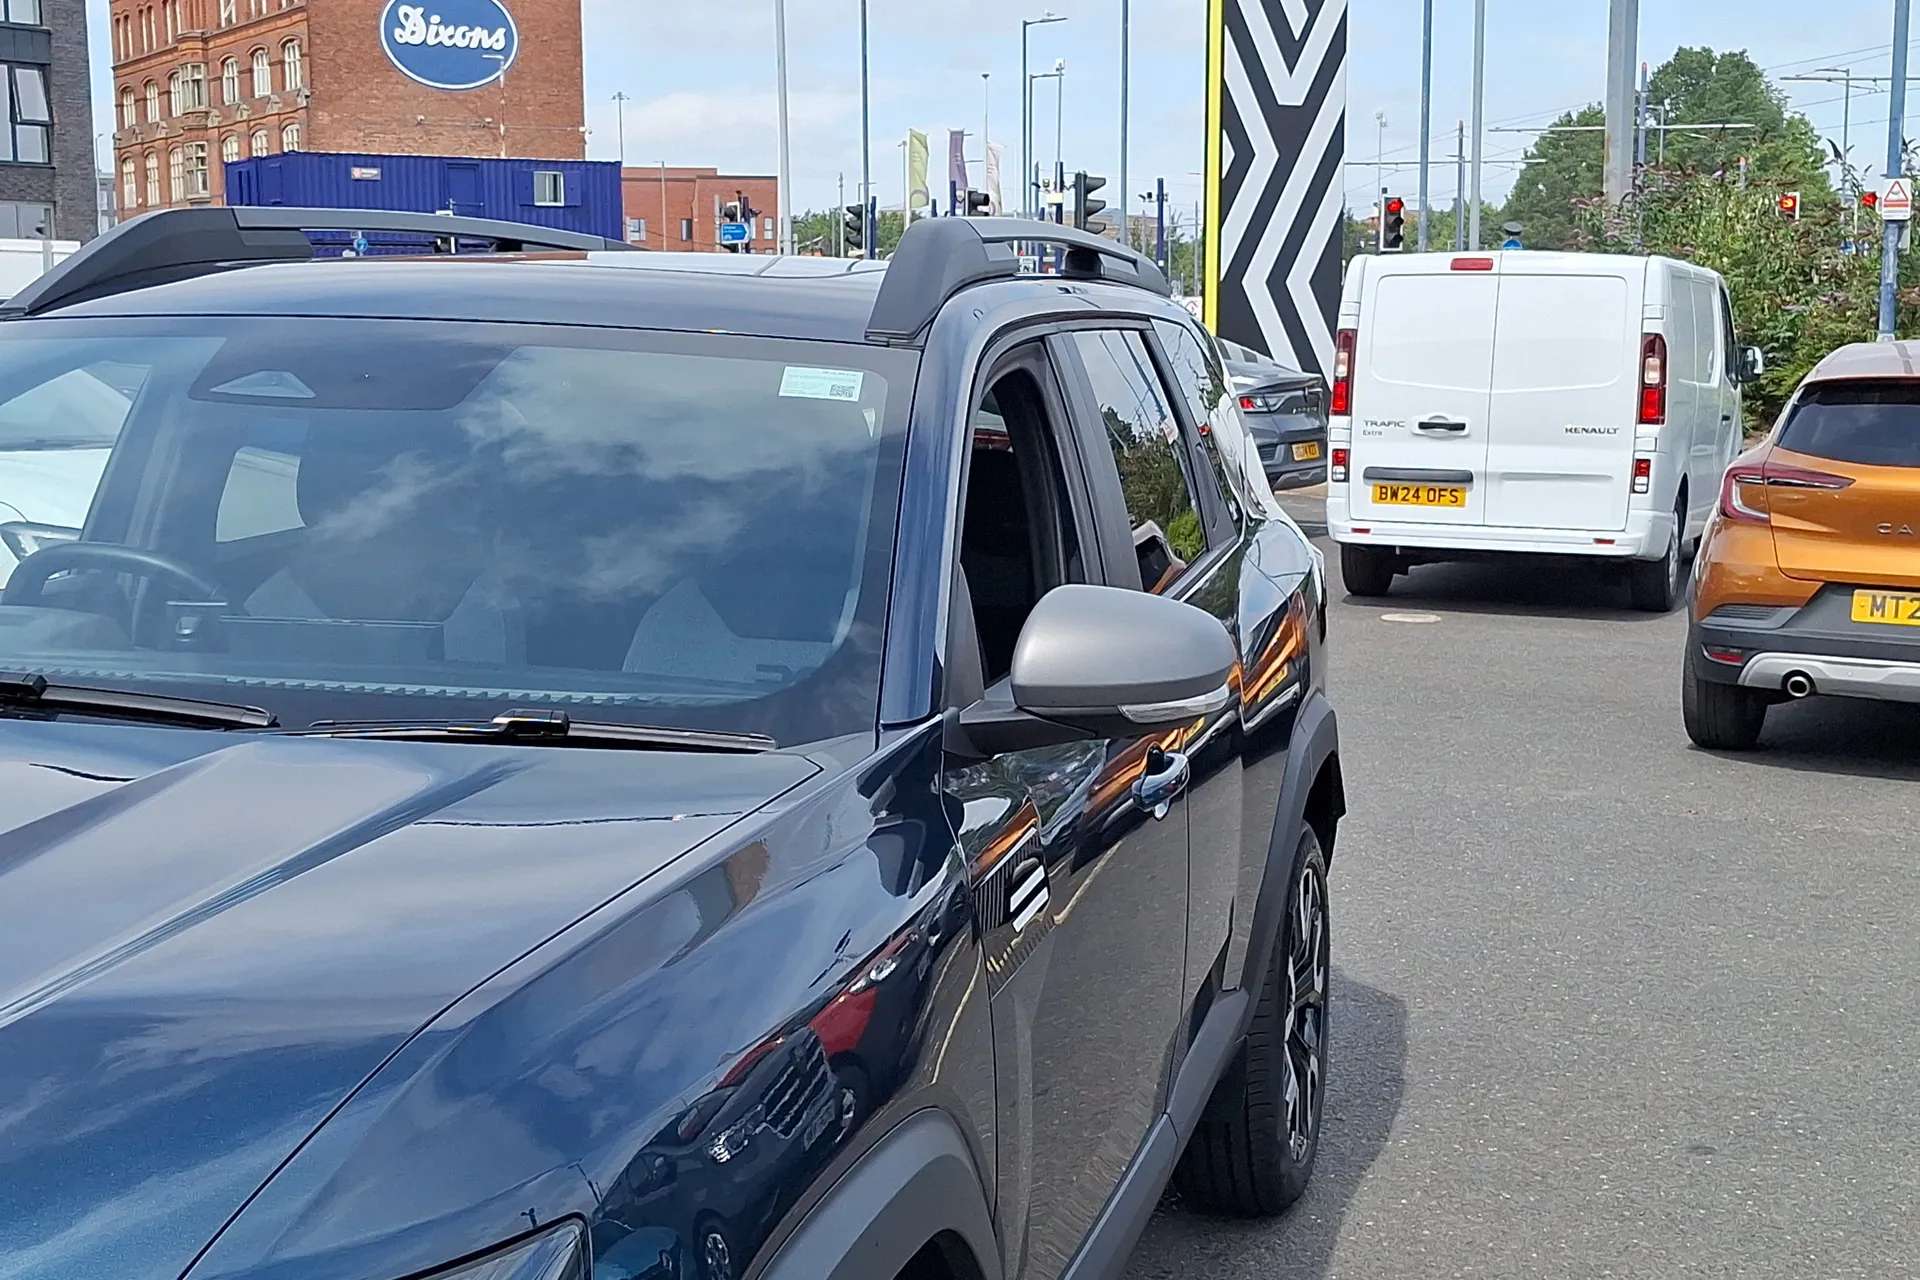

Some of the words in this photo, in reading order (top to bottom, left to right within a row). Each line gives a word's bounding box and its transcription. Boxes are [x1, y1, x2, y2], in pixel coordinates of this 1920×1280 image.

[394, 5, 506, 50] Dixons
[1363, 420, 1406, 428] TRAFIC
[1564, 426, 1619, 434] RENAULT
[1379, 486, 1421, 502] BW24
[1427, 488, 1459, 504] OFS
